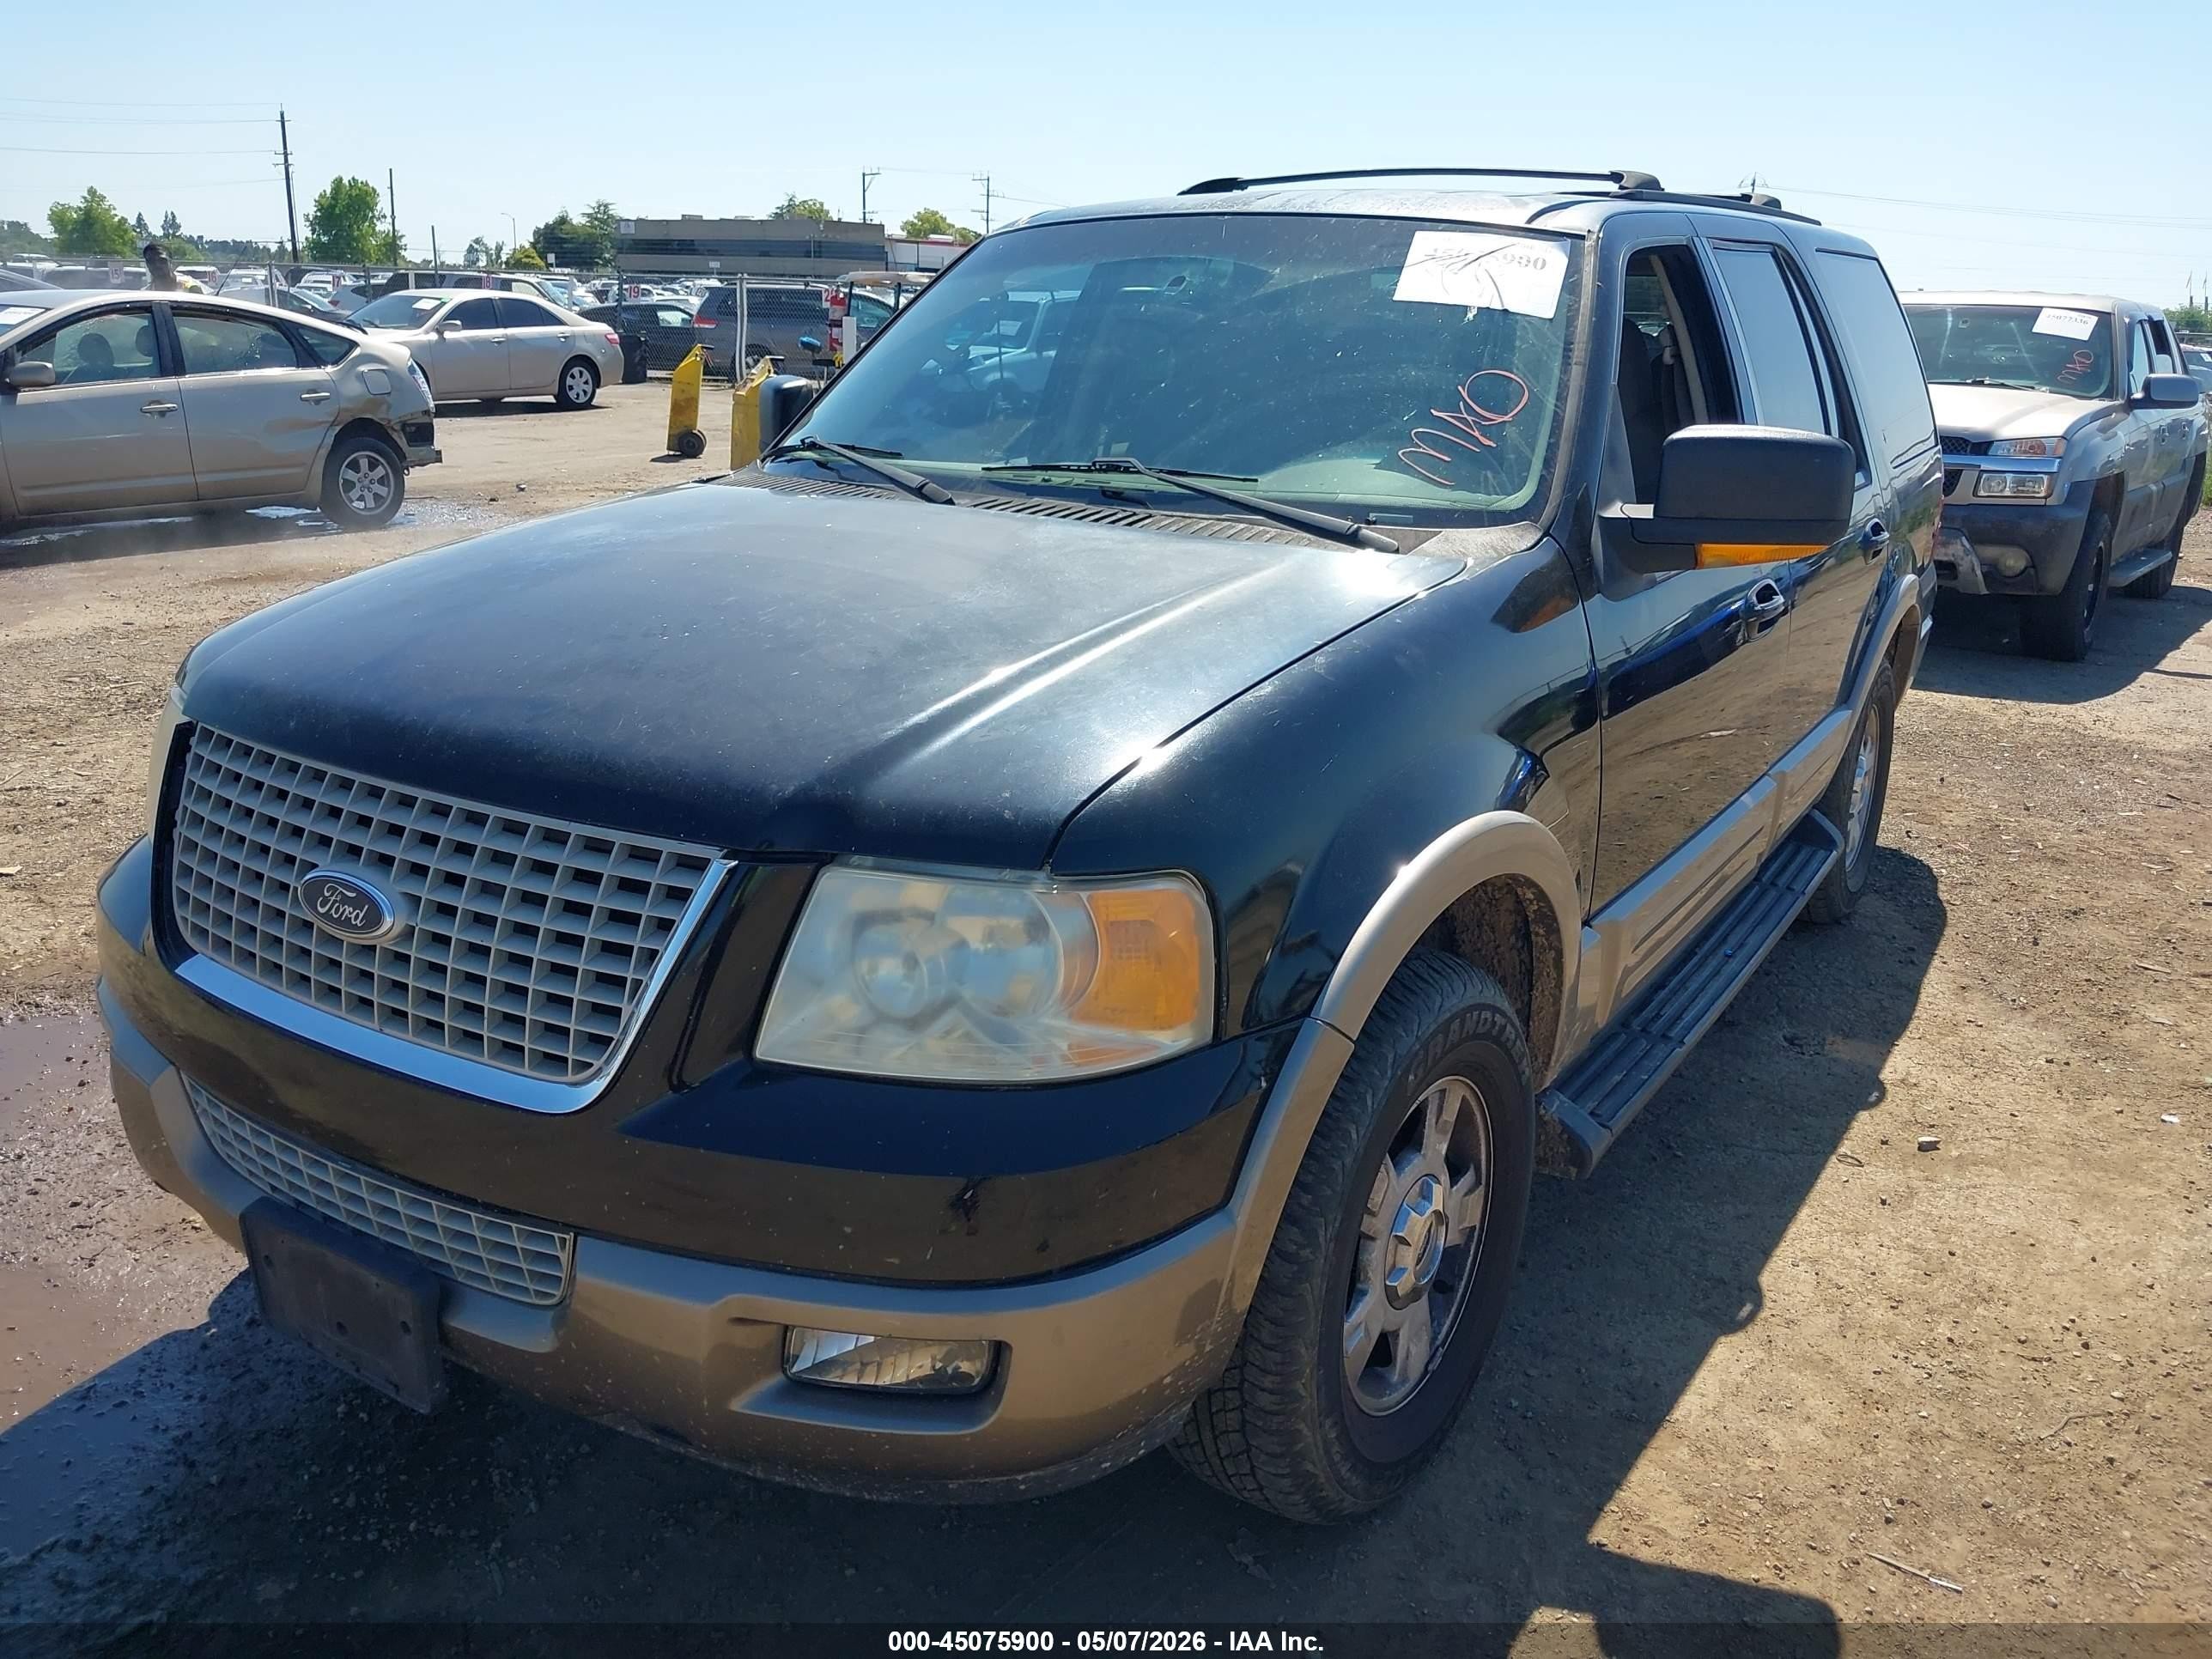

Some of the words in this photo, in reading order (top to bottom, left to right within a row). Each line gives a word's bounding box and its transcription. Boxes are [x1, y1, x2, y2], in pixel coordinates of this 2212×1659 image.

[208, 268, 217, 283] 16
[332, 275, 341, 287] 17
[483, 275, 490, 288] 18
[629, 285, 640, 298] 19
[317, 883, 369, 927] Ford
